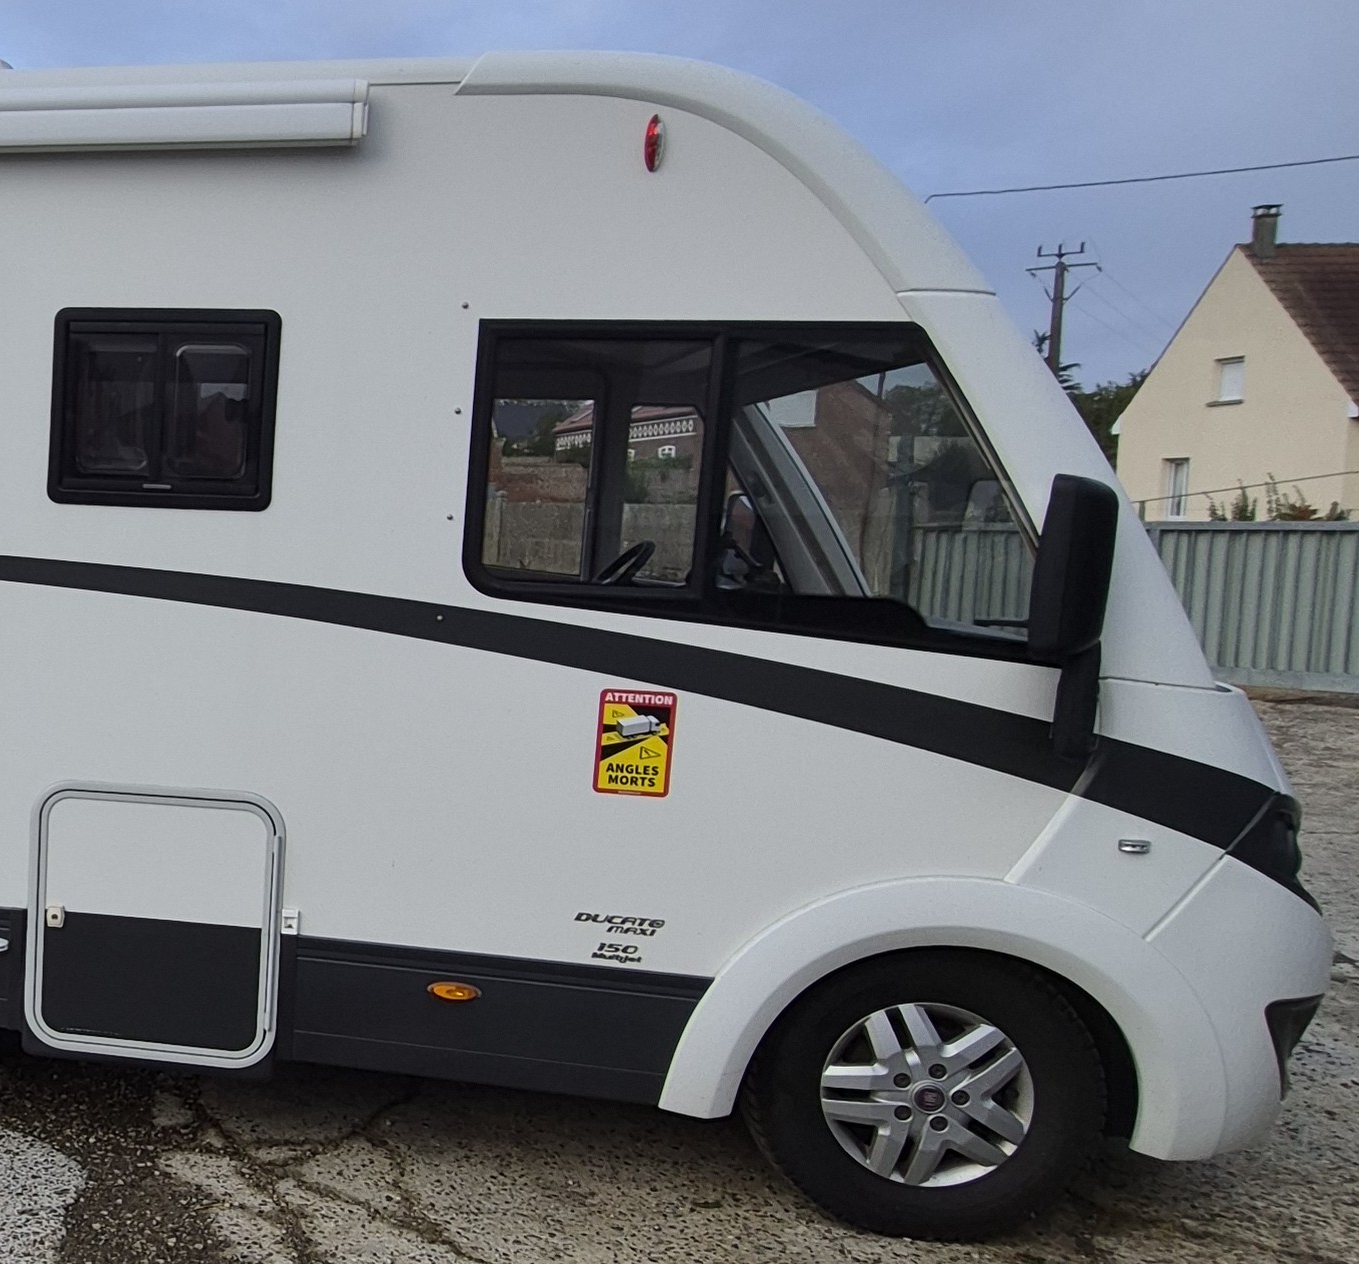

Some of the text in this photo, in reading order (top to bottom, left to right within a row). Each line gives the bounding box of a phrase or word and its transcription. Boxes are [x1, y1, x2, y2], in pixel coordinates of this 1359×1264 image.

[605, 692, 674, 705] ATTENTION
[606, 763, 659, 776] ANGLES
[608, 774, 656, 788] MORTS
[574, 912, 666, 929] DUCATO
[597, 942, 639, 955] 150
